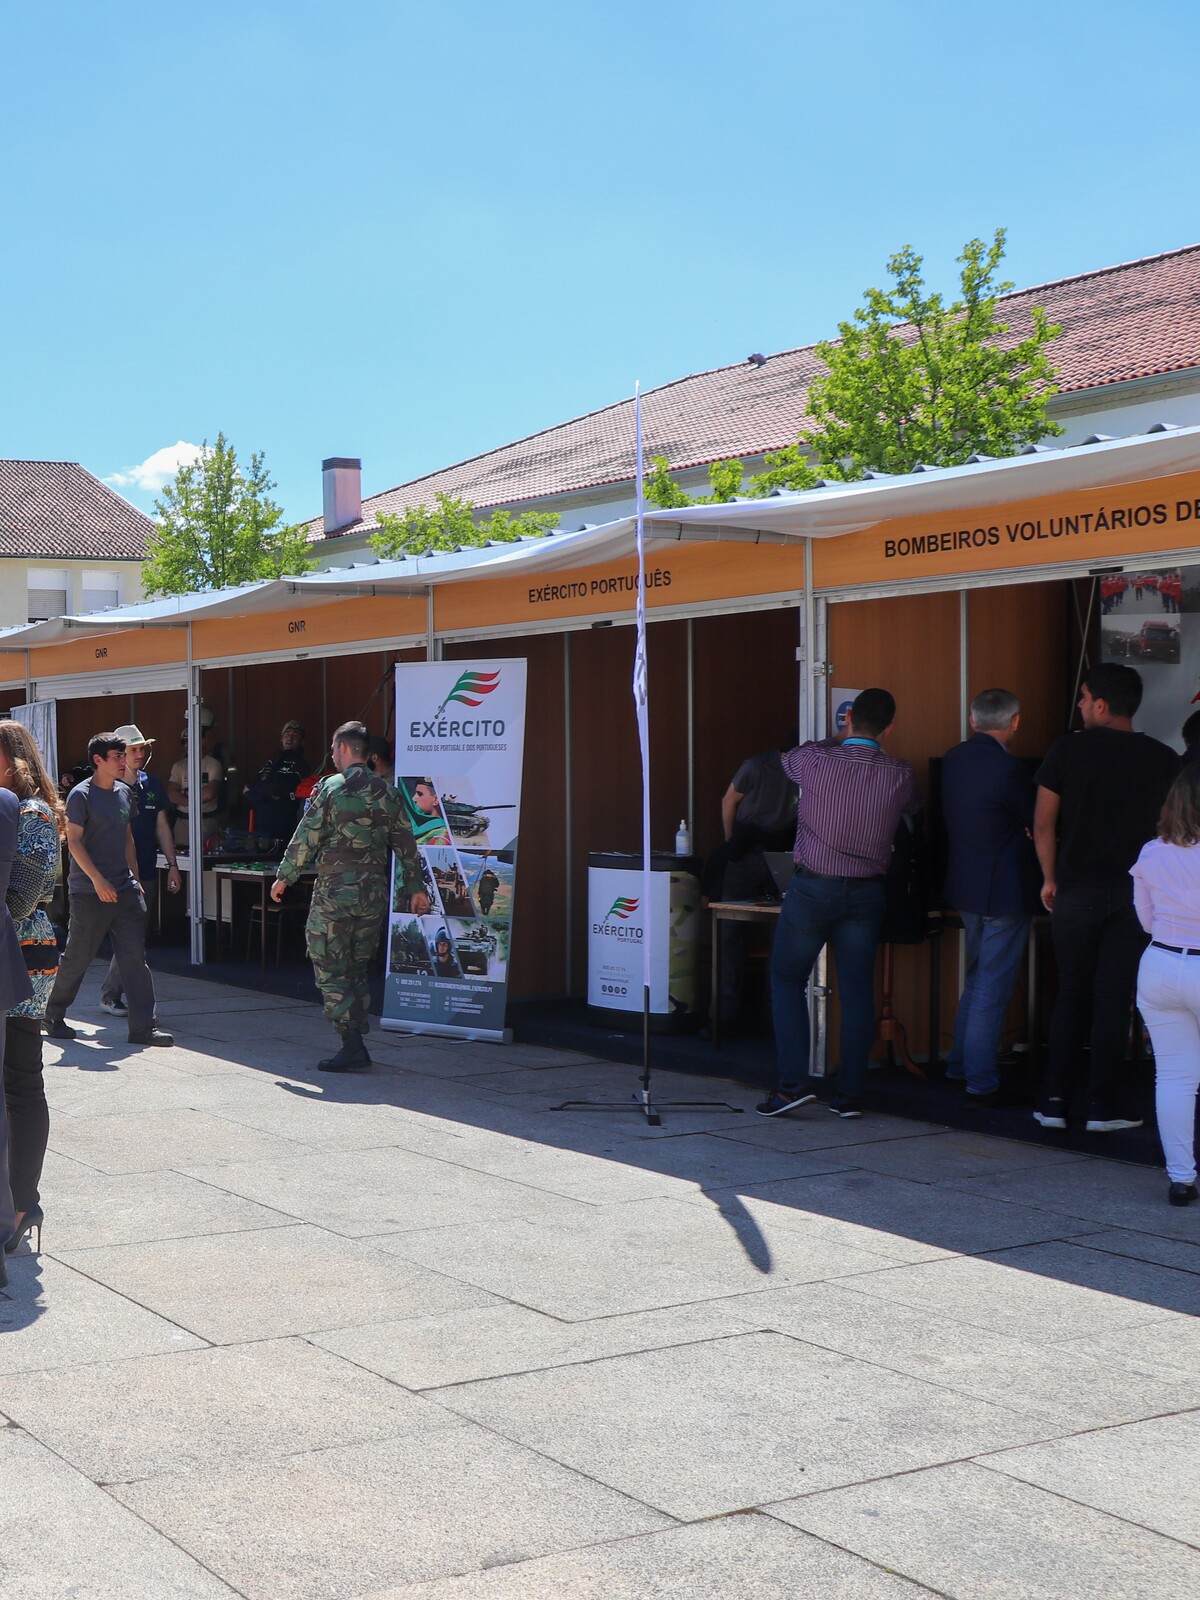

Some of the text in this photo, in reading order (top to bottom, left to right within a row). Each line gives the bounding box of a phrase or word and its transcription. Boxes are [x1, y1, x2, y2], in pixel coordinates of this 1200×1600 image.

[884, 526, 1000, 557] BOMBEIROS
[1006, 504, 1168, 542] VOLUNTÁRIOS
[528, 583, 588, 603] EXÉRCITO
[288, 621, 306, 633] GNR
[95, 648, 108, 659] GNR
[410, 716, 506, 738] EXÉRCITO
[406, 744, 413, 752] AO
[413, 744, 433, 753] SERVIÇO
[433, 744, 440, 752] DE
[440, 744, 461, 752] PORTUGAL
[462, 744, 466, 752] E
[476, 743, 507, 751] PORTUGUESES
[593, 922, 644, 939] EXÉRCITO
[617, 937, 644, 945] PORTUGAL
